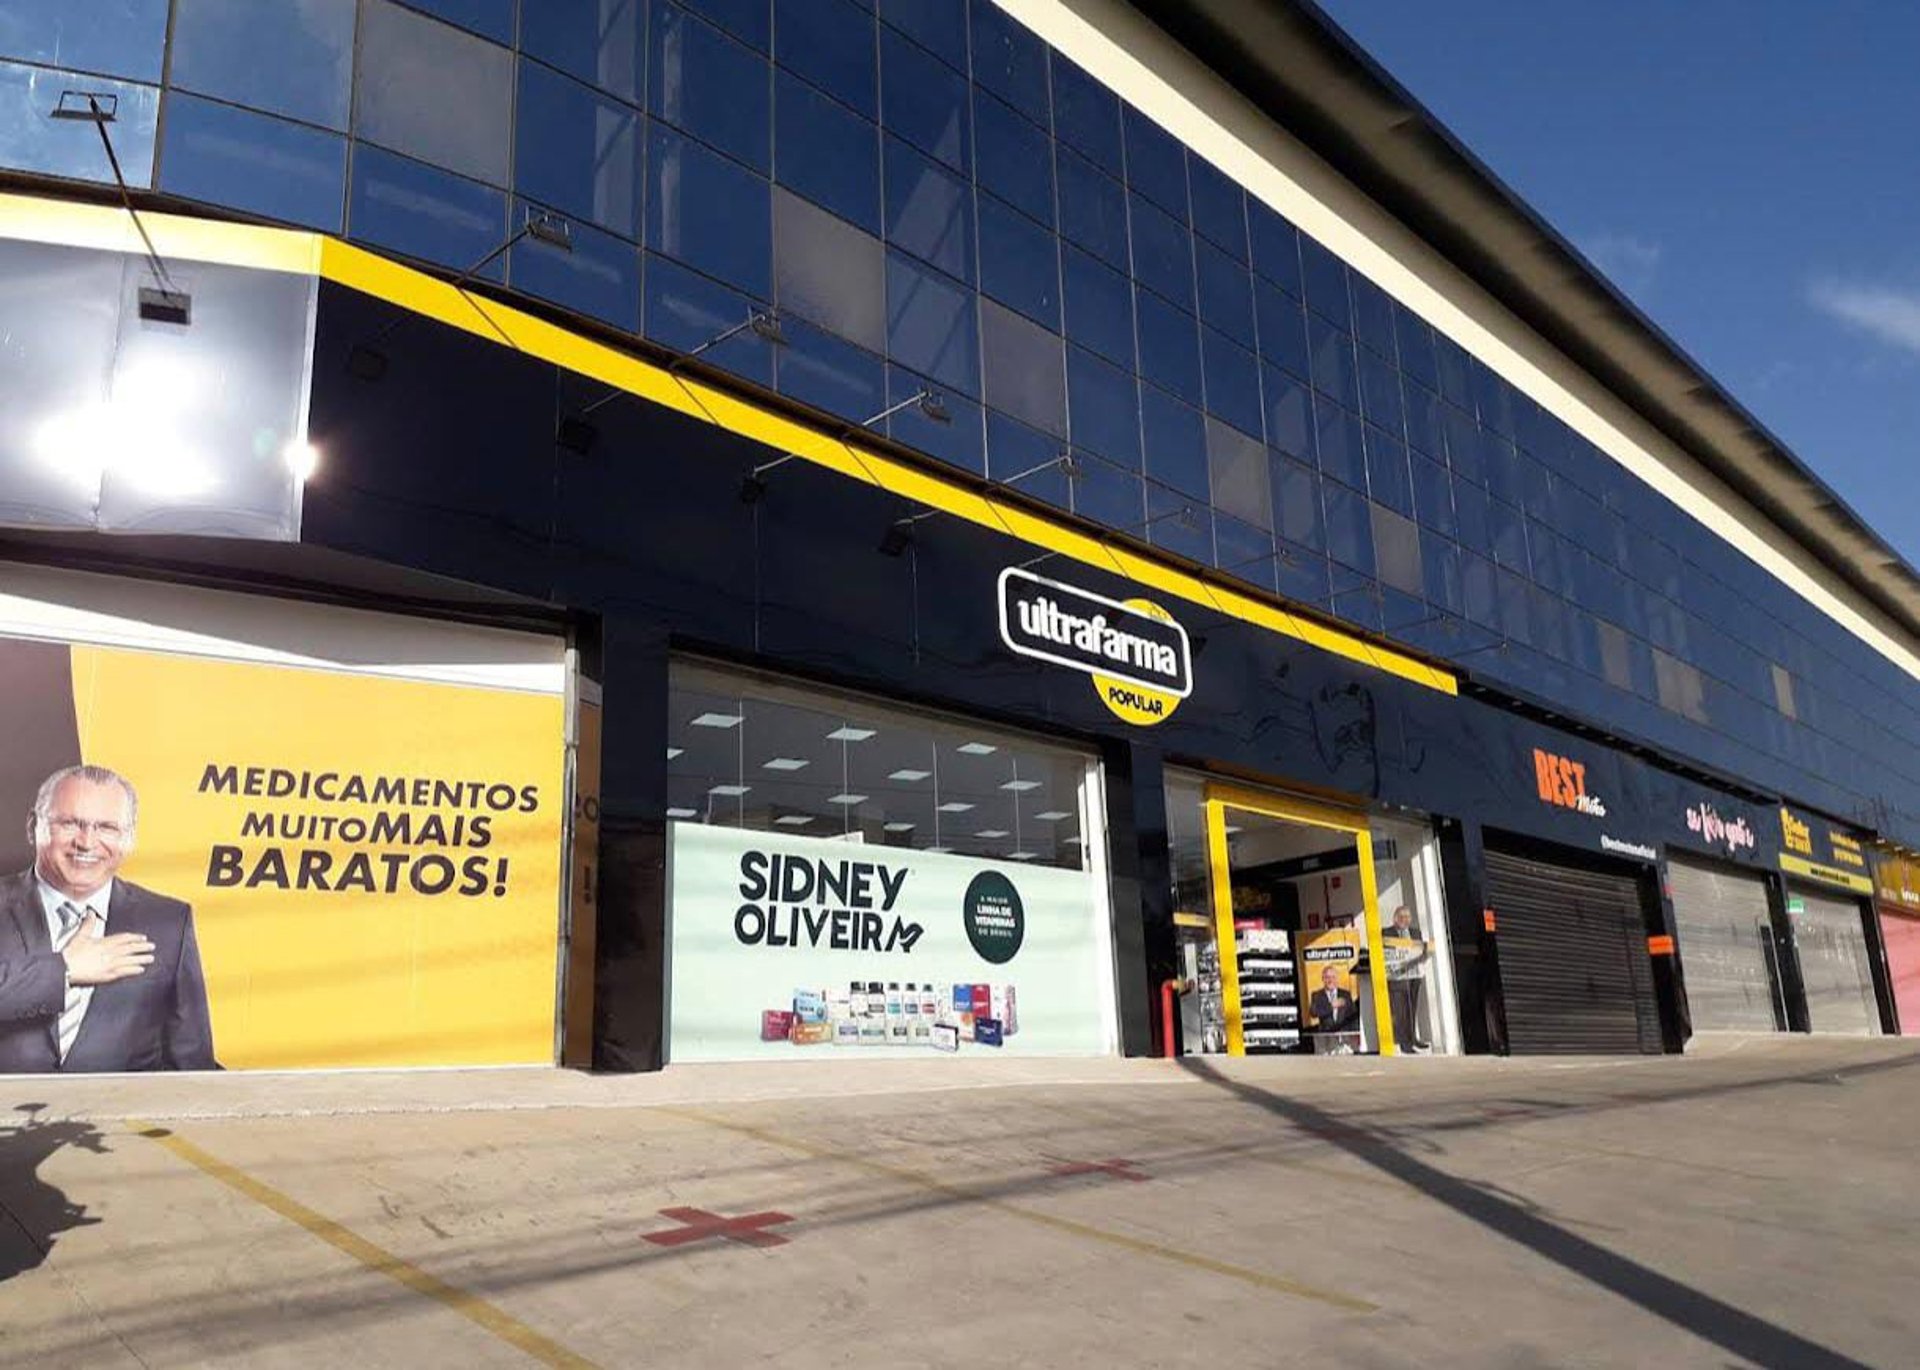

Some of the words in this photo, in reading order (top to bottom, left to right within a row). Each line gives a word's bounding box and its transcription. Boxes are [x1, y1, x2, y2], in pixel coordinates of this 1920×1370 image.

[1017, 596, 1177, 677] ultrafarma
[1108, 687, 1163, 716] POPULAR
[198, 764, 539, 813] MEDICAMENTOS
[1533, 748, 1585, 808] BEST
[241, 812, 367, 844] MUITO
[368, 811, 493, 848] MAIS
[206, 844, 509, 897] BARATOS!
[738, 850, 909, 911] SIDNEY
[1305, 947, 1353, 960] ultrafarma
